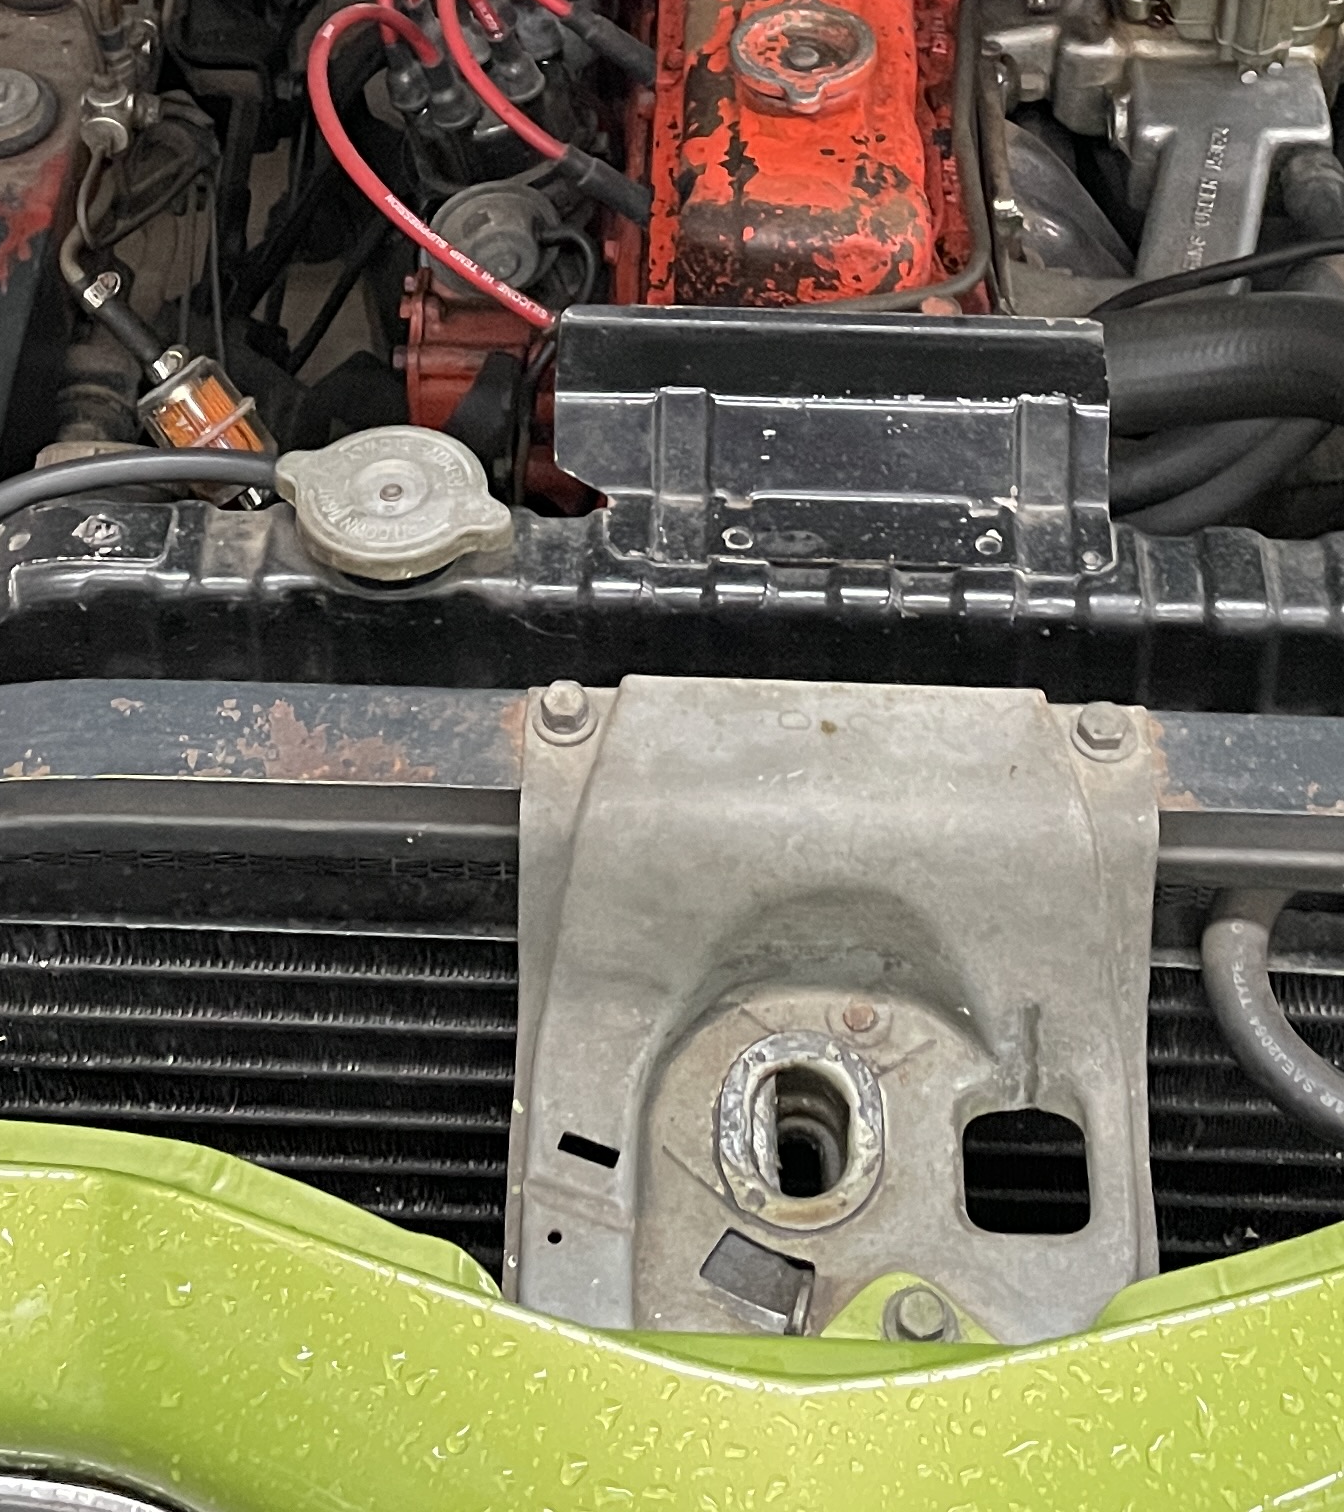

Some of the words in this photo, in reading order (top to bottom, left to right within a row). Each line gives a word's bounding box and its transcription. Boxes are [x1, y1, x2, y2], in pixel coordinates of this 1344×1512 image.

[384, 194, 449, 250] SUPPRESSION
[449, 249, 478, 274] TEMP
[481, 271, 495, 284] HI
[496, 282, 548, 319] SILICONE
[1231, 960, 1253, 1010] TYPE
